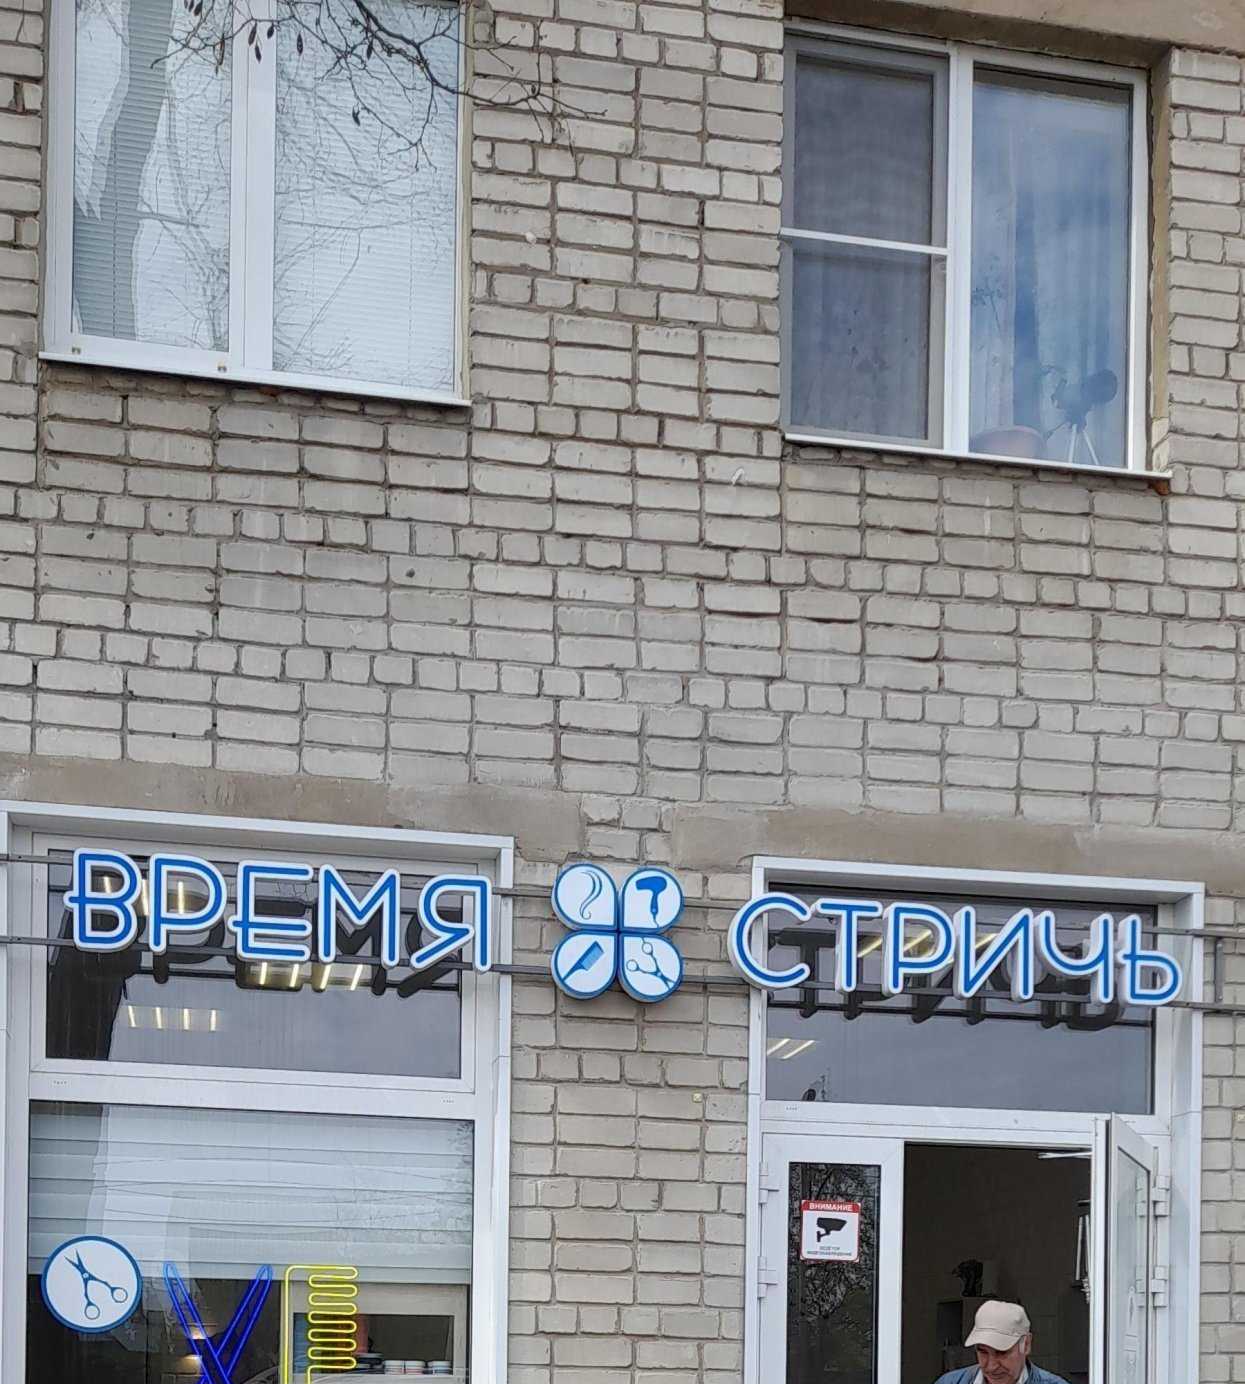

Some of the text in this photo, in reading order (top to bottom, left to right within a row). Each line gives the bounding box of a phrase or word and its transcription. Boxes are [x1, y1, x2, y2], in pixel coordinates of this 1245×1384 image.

[65, 848, 1184, 1004] ВРЕМЯ СТРИЧЬ
[809, 1202, 853, 1211] ВНИМАНИЕ
